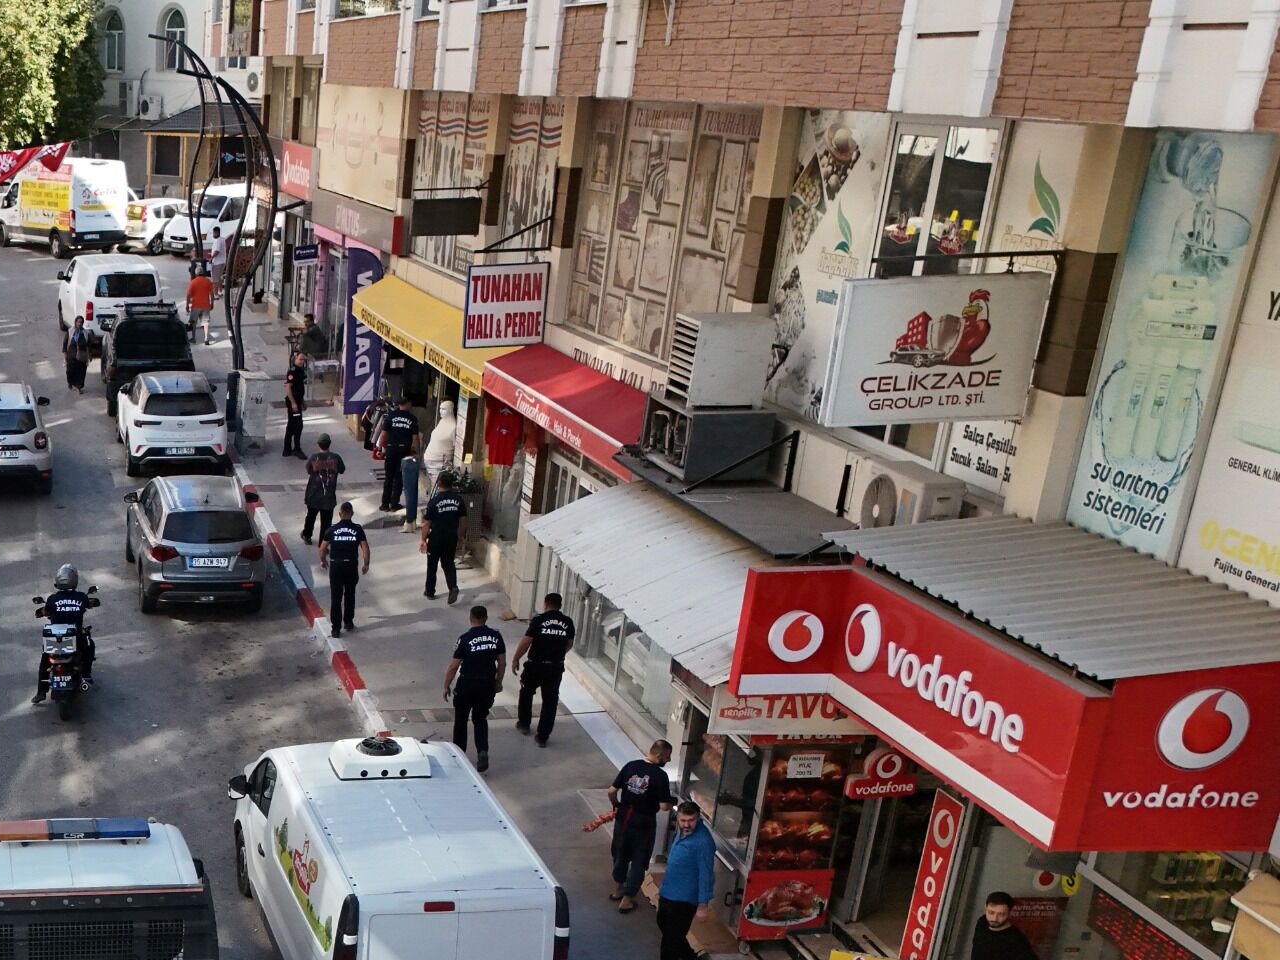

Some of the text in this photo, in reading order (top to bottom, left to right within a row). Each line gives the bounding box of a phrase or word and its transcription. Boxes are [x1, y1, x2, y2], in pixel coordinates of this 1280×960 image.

[472, 273, 543, 304] TUNAHAN
[467, 311, 542, 340] HALI & PERDE
[860, 369, 1003, 397] ÇELİKZADE
[515, 388, 552, 428] Tunahan
[868, 390, 985, 411] GROUP LTD. ŞTİ.
[963, 424, 985, 446] Salça
[950, 447, 972, 468] Sucuk
[976, 456, 999, 479] Salam
[1228, 456, 1280, 483] GENERAL KLİM
[1091, 462, 1170, 505] su arıtma
[1083, 488, 1168, 534] sistemleri
[333, 526, 357, 536] TORBALI
[333, 534, 357, 542] ZABITA
[1220, 527, 1280, 577] GEN
[1214, 557, 1280, 593] Fujitsu General
[54, 599, 82, 608] TORBALI
[541, 619, 569, 630] TORBALI
[541, 628, 567, 637] ZABITA
[468, 635, 499, 647] TORBALI
[470, 643, 497, 652] ZABITA
[888, 641, 1024, 753] vodafone
[856, 781, 914, 796] vodafone
[1103, 784, 1260, 809] vodafone
